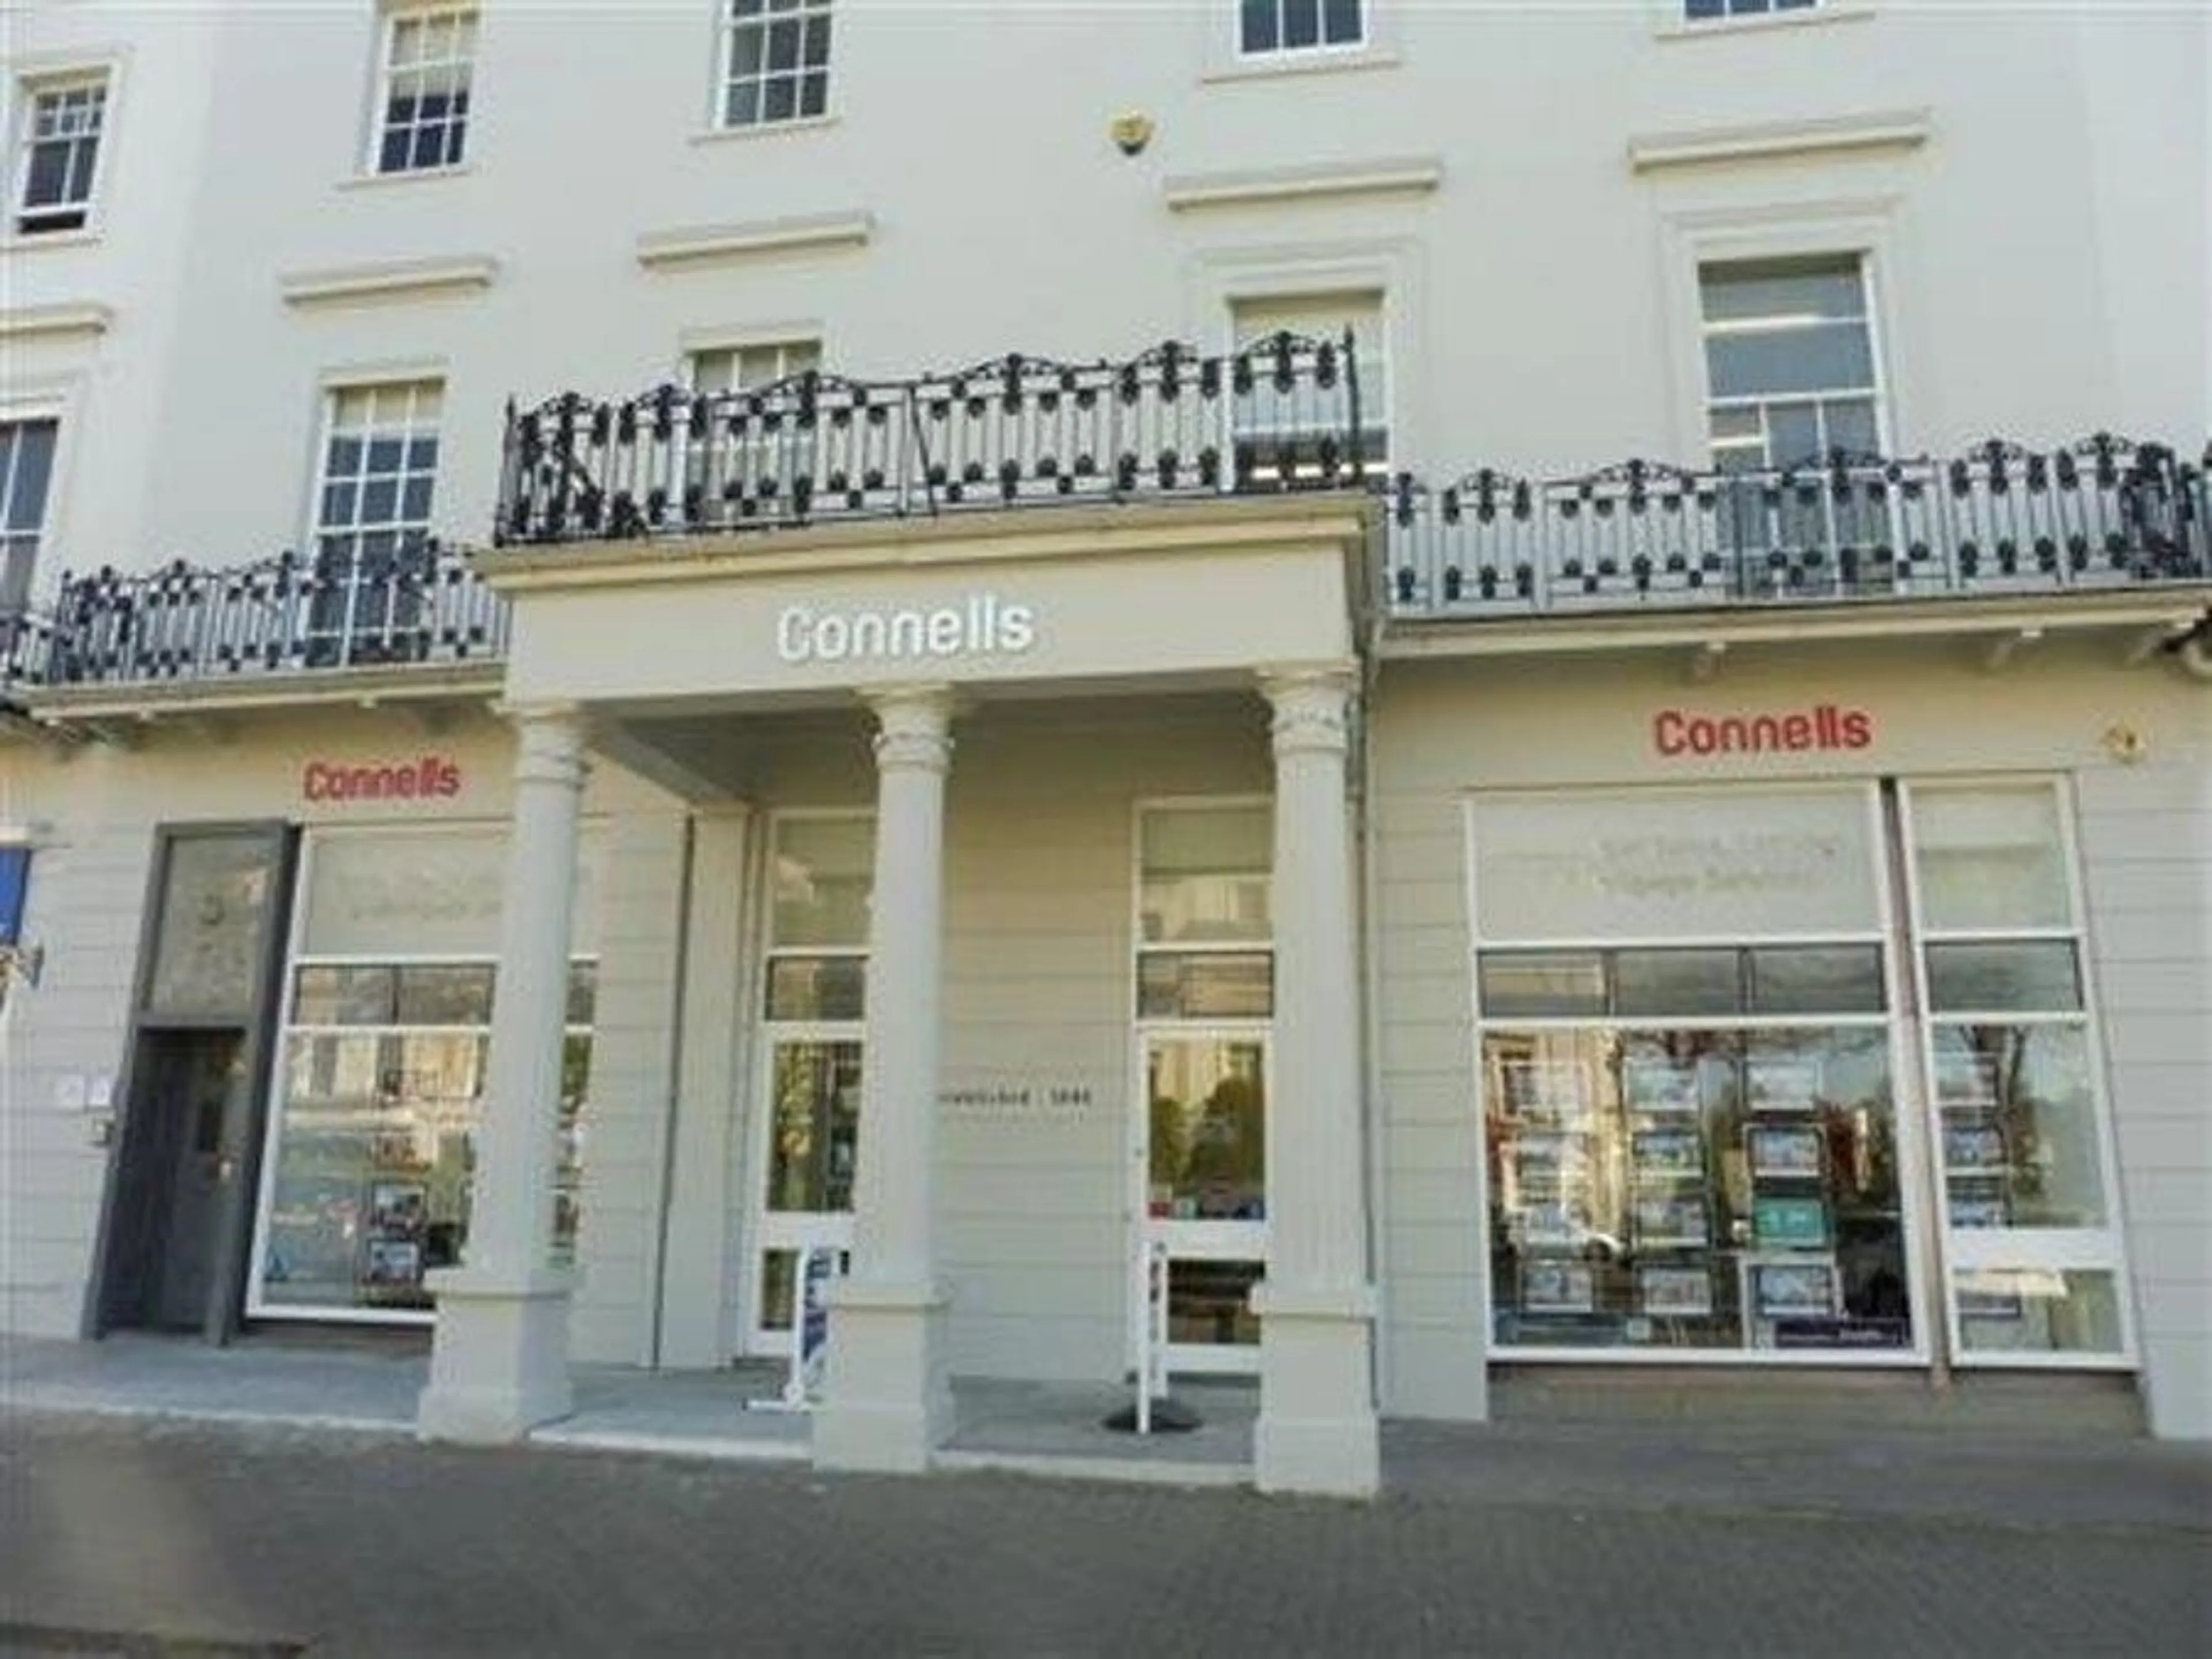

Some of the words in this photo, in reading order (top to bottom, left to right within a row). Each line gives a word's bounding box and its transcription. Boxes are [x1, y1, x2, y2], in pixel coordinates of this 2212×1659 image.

[776, 592, 1035, 662] Connells
[1655, 705, 1872, 756] Connells
[304, 757, 460, 801] Connells
